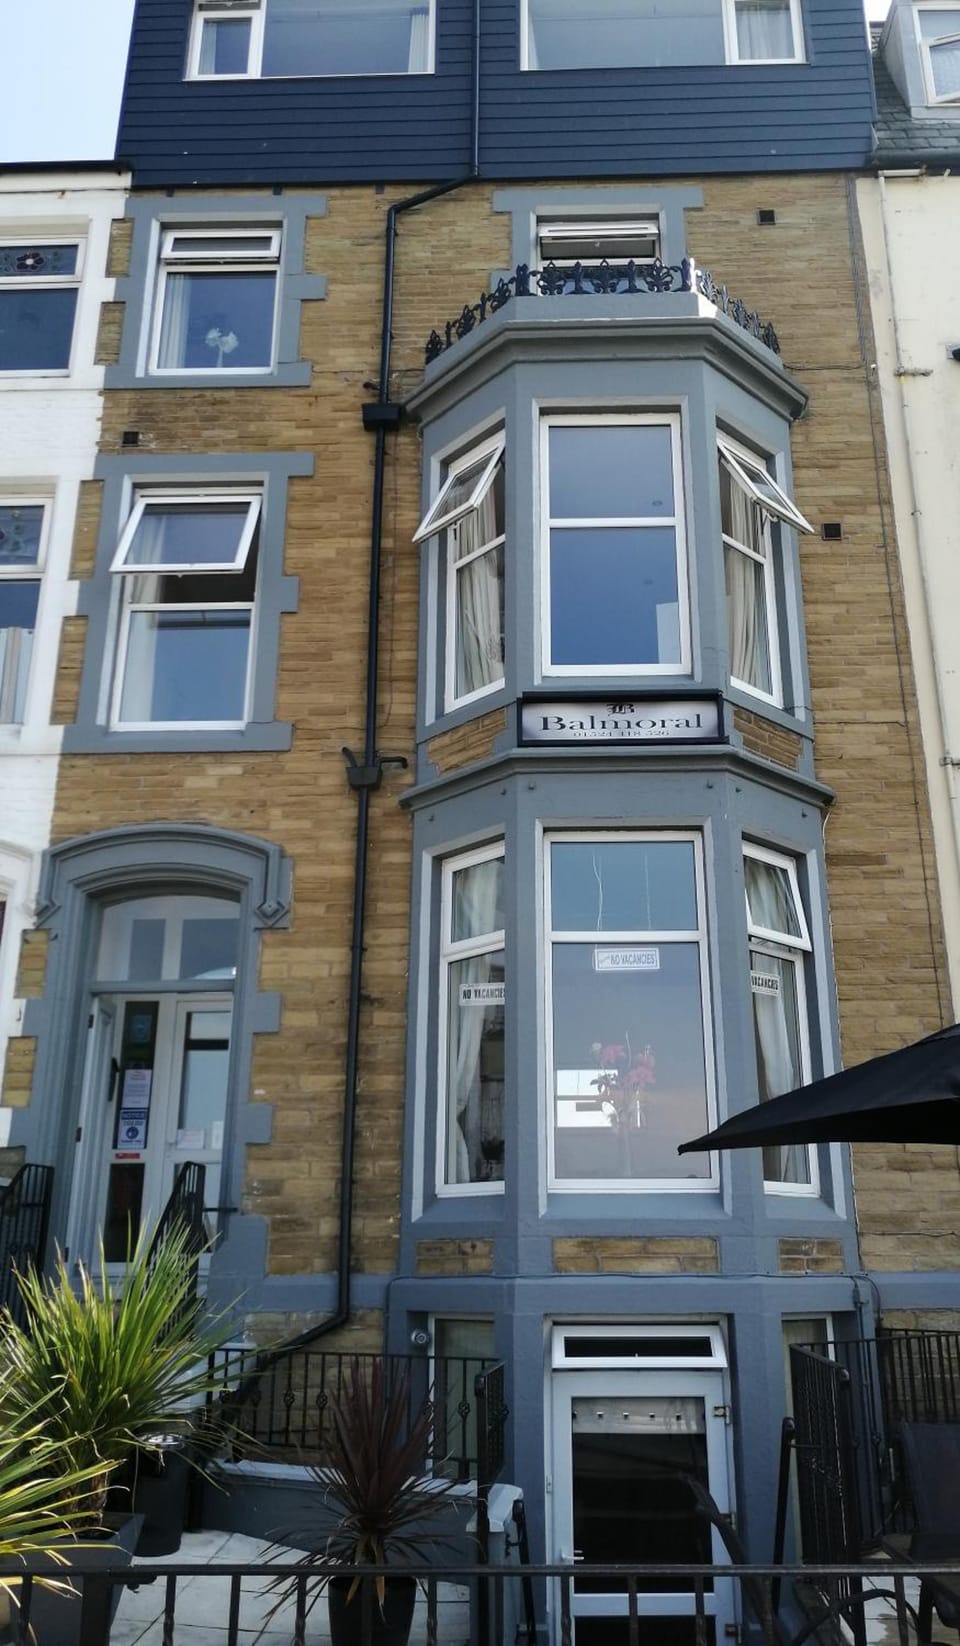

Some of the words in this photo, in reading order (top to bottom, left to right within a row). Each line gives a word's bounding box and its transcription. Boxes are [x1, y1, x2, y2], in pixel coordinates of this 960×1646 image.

[539, 714, 703, 731] Balmoral
[610, 953, 620, 965] NO
[620, 952, 655, 965] VACANCIES
[463, 989, 472, 1000] NO
[474, 987, 505, 999] VACANCIE
